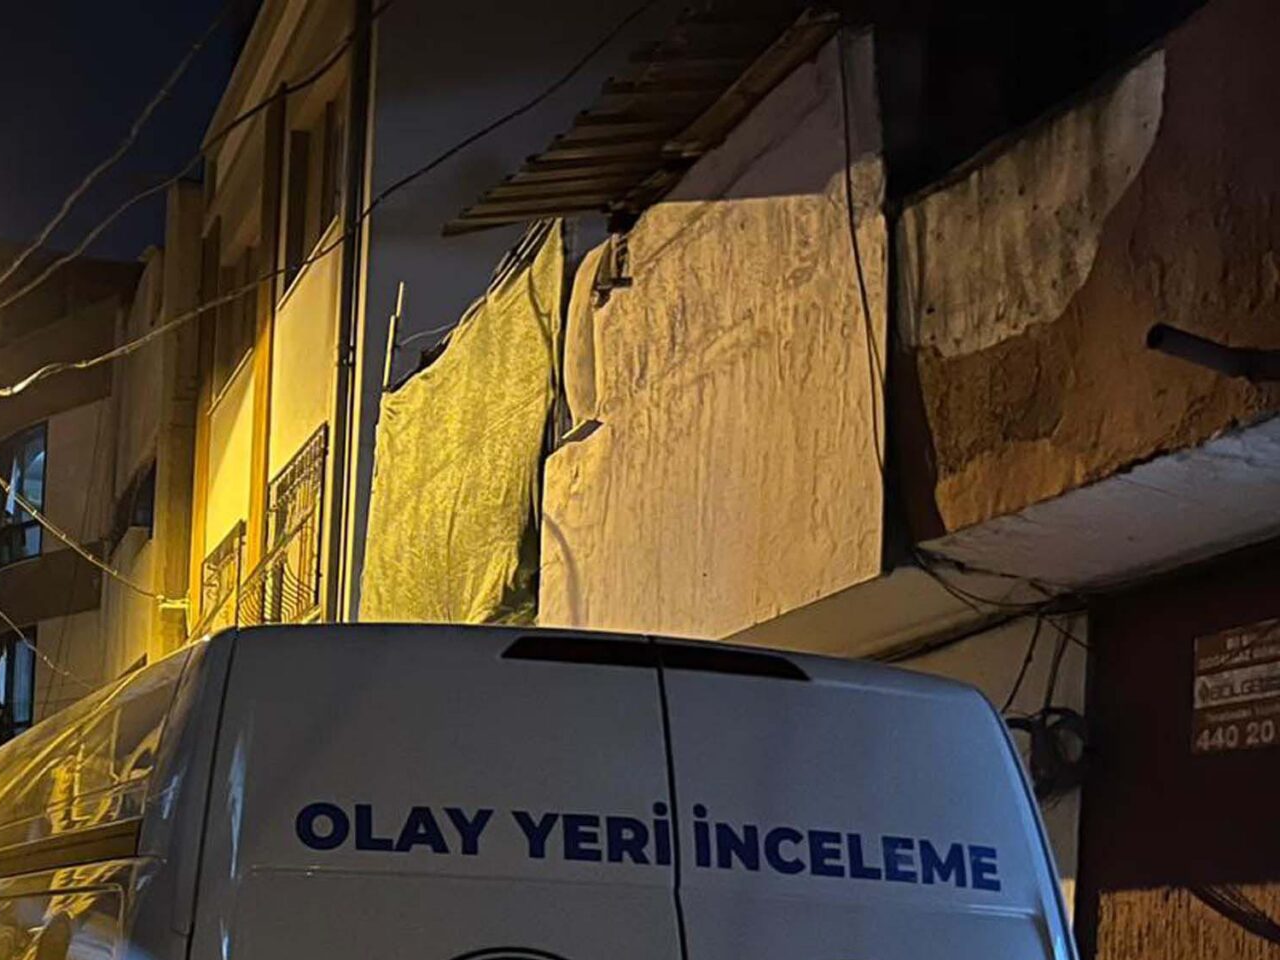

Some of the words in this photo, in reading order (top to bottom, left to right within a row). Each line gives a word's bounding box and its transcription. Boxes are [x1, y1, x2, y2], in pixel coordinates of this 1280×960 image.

[1196, 723, 1239, 751] 440
[1246, 718, 1276, 745] 20
[295, 802, 494, 855] OLAY
